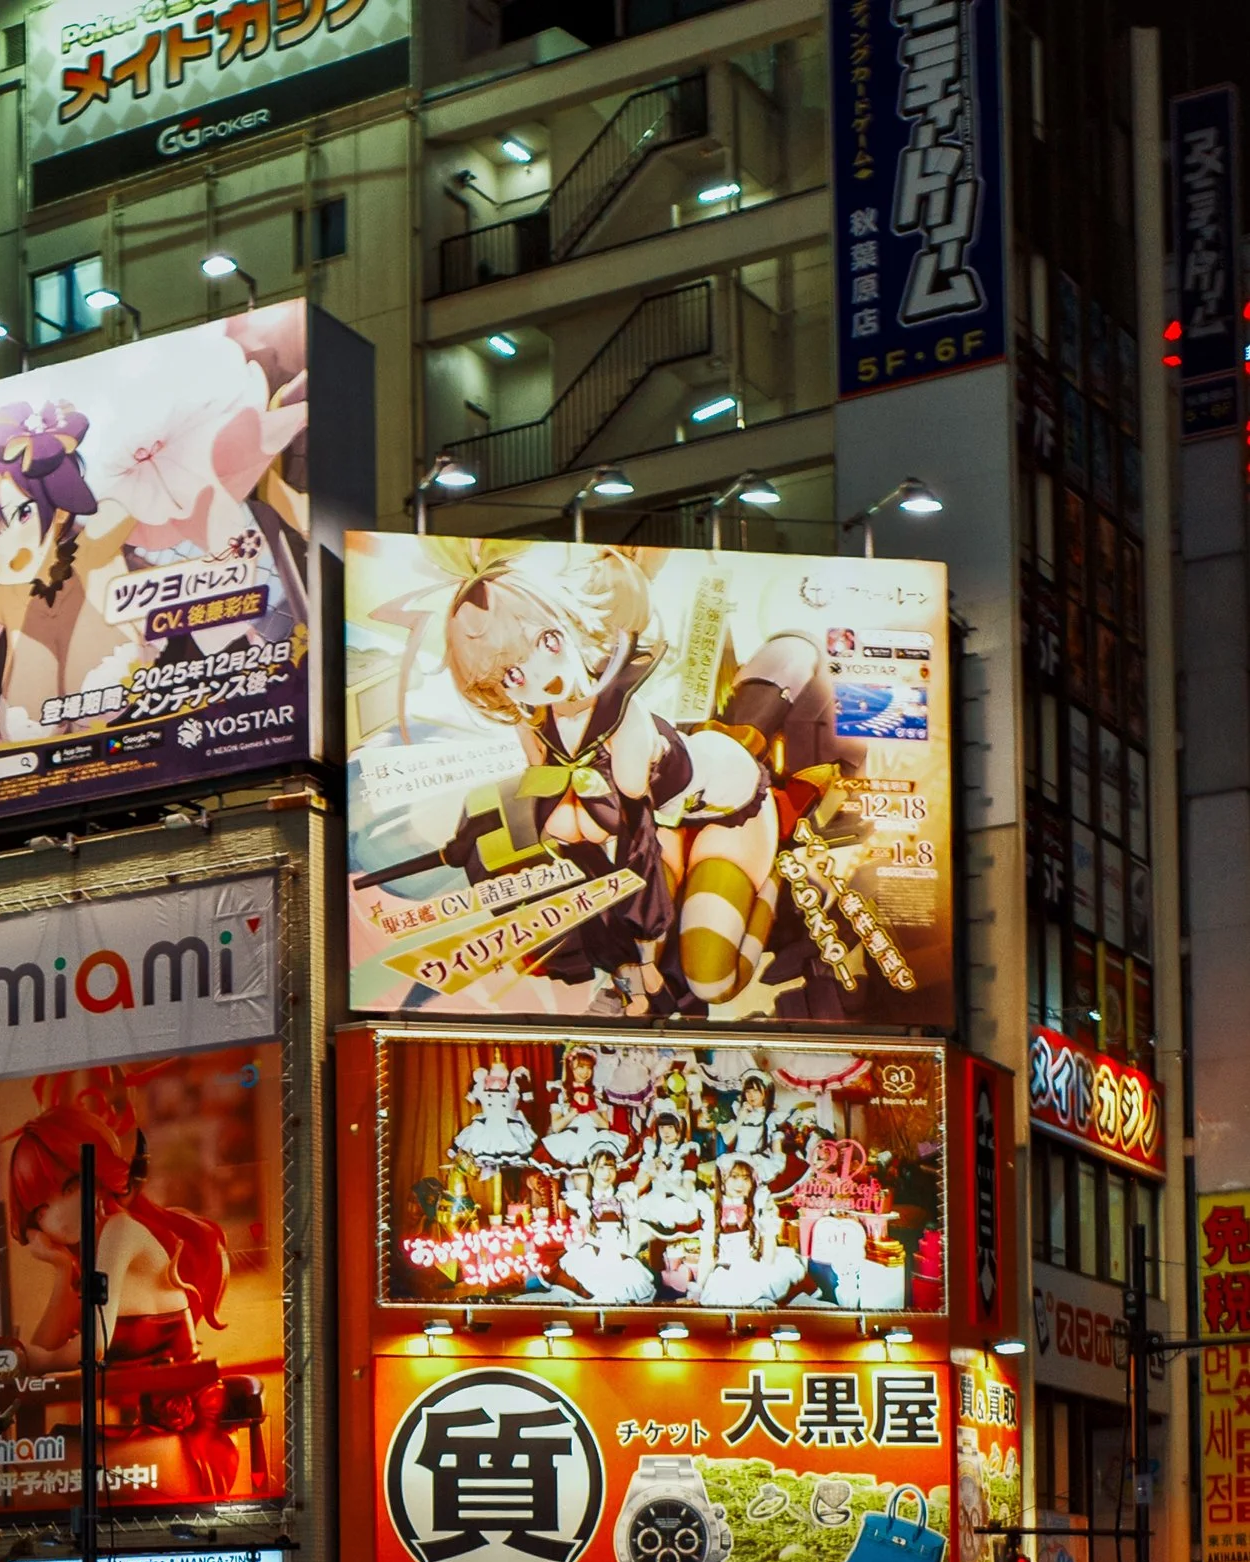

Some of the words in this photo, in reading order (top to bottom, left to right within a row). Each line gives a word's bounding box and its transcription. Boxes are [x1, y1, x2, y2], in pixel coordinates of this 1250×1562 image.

[851, 207, 880, 338] 秋葉原店
[132, 640, 293, 694] 2025年12月24日
[845, 665, 897, 676] YOSTAR
[204, 705, 295, 737] YOSTAR
[862, 794, 926, 820] 12.18
[894, 841, 933, 865] 1.8
[381, 903, 437, 934] 駆逐艦
[440, 890, 472, 917] CV
[479, 861, 575, 905] 諸星すみれ
[1030, 1040, 1159, 1156] メイドカジノ
[14, 1377, 61, 1393] Ver.
[616, 1418, 710, 1447] チケット
[721, 1370, 942, 1448] 大黒屋
[1204, 1346, 1234, 1526] 면세점
